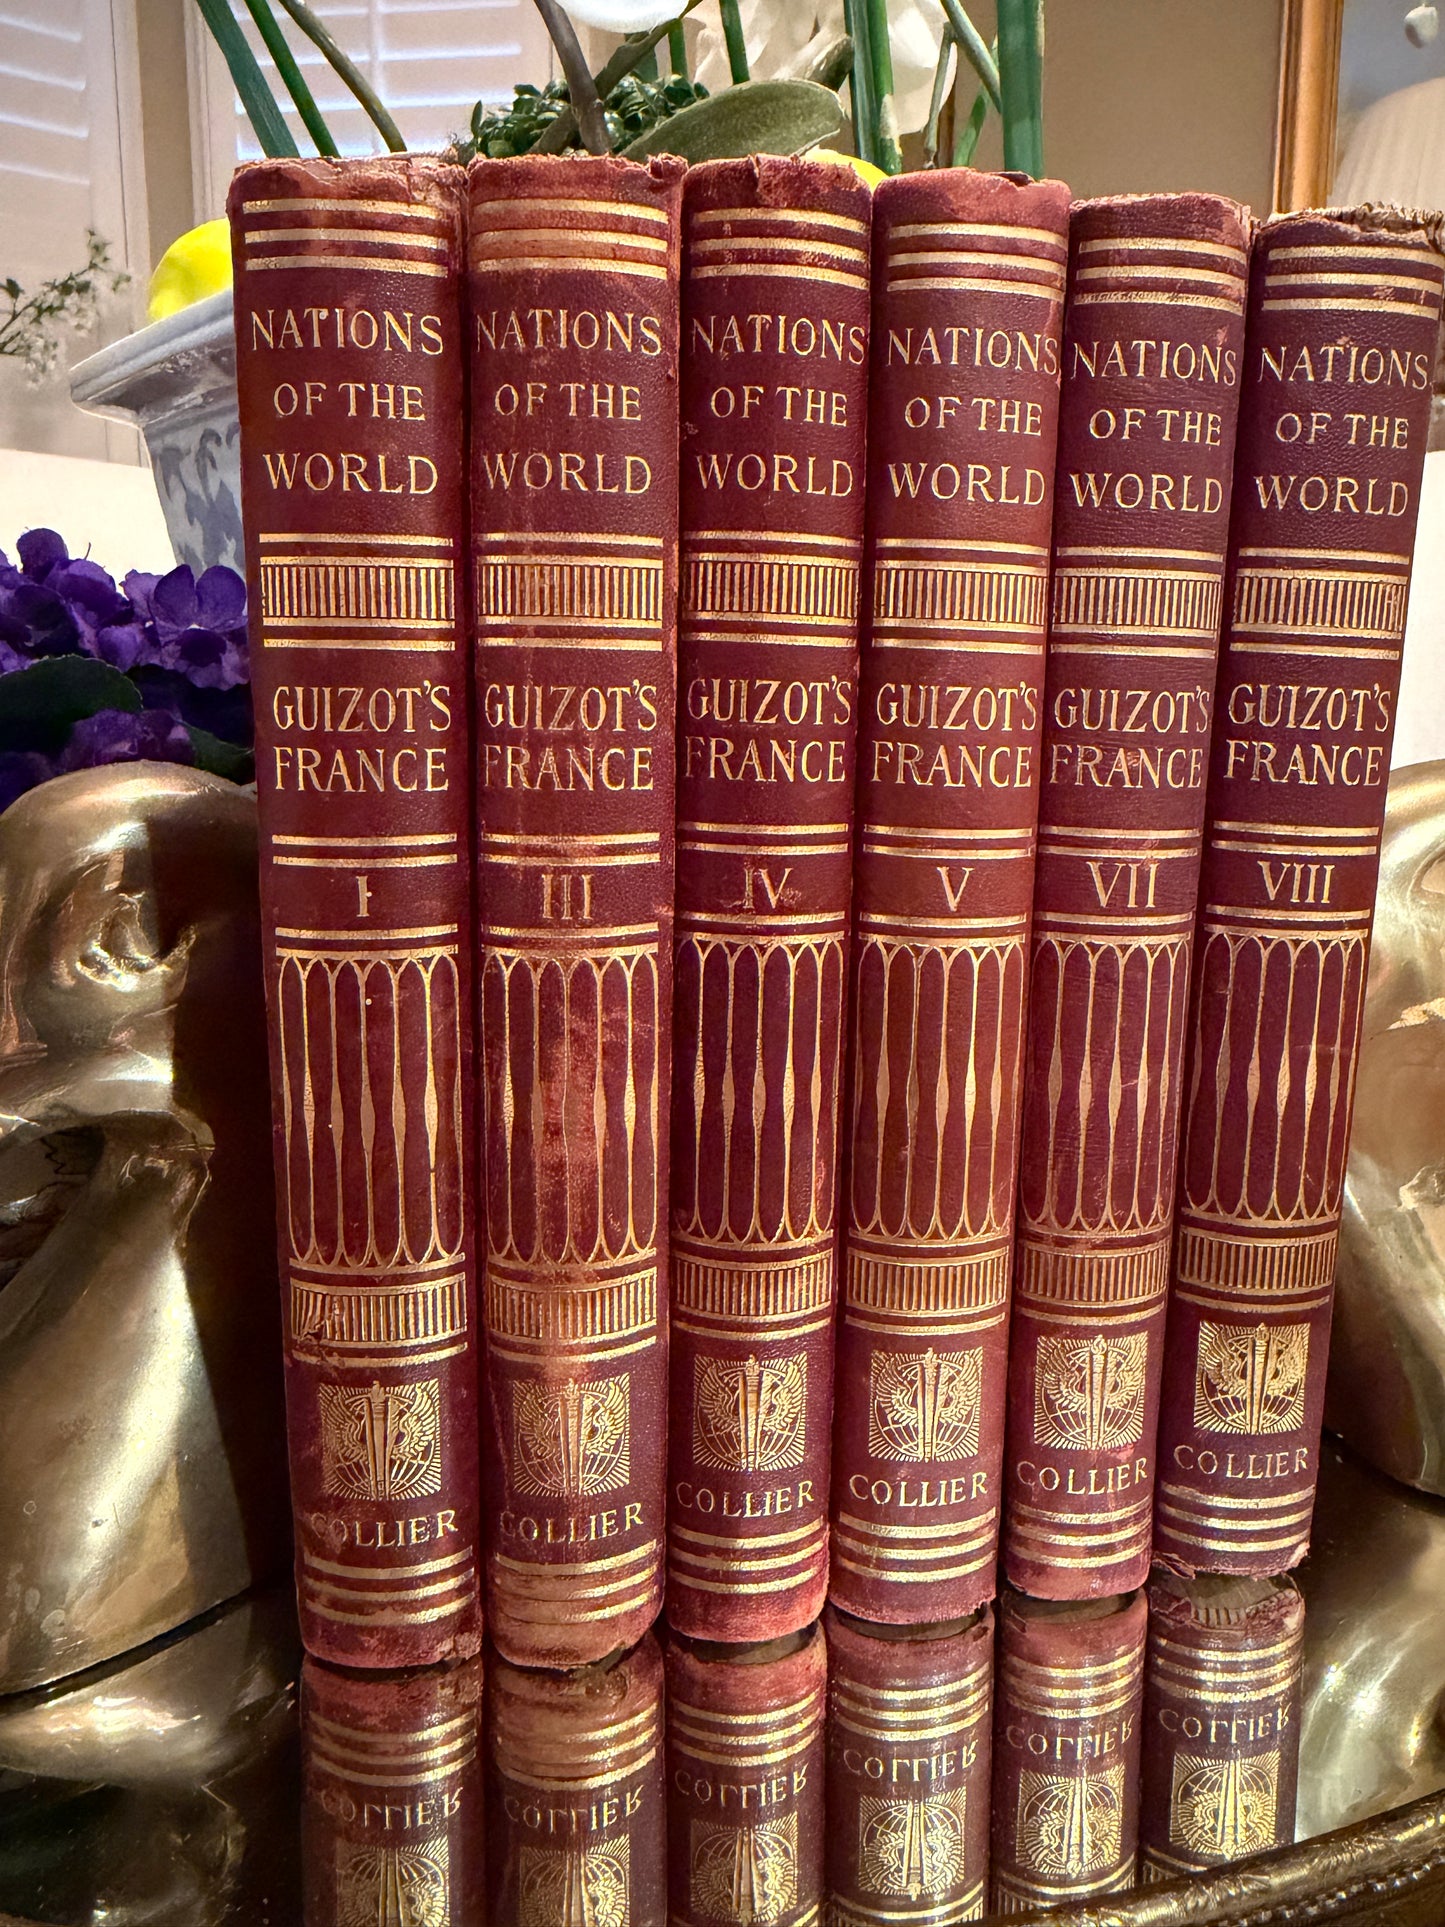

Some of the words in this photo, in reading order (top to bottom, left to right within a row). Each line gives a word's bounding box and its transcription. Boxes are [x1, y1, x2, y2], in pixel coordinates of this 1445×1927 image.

[251, 309, 443, 355] NATIONS
[476, 308, 661, 356] NATIONS
[691, 313, 866, 365] NATIONS
[887, 326, 1058, 376] NATIONS
[1072, 340, 1236, 386] NATIONS
[1258, 345, 1430, 390] NATIONS
[273, 382, 326, 417] OF
[339, 382, 426, 420] THE
[495, 382, 548, 417] OF
[560, 382, 642, 420] THE
[711, 385, 764, 418] OF
[776, 385, 848, 427] THE
[905, 397, 961, 429] OF
[971, 398, 1042, 436] THE
[1089, 408, 1145, 440] OF
[1155, 409, 1222, 446] THE
[1275, 412, 1331, 445] OF
[1342, 413, 1409, 449] THE
[262, 452, 438, 494] WORLD
[482, 452, 651, 494] WORLD
[696, 452, 853, 497] WORLD
[888, 462, 1046, 505] WORLD
[1070, 473, 1223, 513] WORLD
[1254, 475, 1409, 518] WORLD
[273, 680, 451, 733] GUIZOT'S
[483, 679, 658, 732] GUIZOT'S
[688, 675, 852, 725] GUIZOT'S
[876, 681, 1038, 732] GUIZOT'S
[1054, 685, 1210, 735] GUIZOT'S
[1227, 681, 1391, 733] GUIZOT'S
[273, 747, 449, 793] FRANCE
[483, 745, 654, 792] FRANCE
[684, 736, 846, 783] FRANCE
[871, 739, 1033, 788] FRANCE
[1049, 743, 1203, 789] FRANCE
[1223, 739, 1384, 786] FRANCE
[356, 875, 372, 917] I
[541, 873, 594, 920] III
[742, 867, 793, 909] IV
[937, 866, 972, 912] V
[1086, 861, 1157, 909] VII
[1257, 860, 1335, 904] VIII
[1017, 1457, 1148, 1495] COLLIER
[1173, 1444, 1309, 1480] COLLIER
[675, 1479, 814, 1518] COLLIER
[848, 1471, 988, 1507] COLLIER
[500, 1501, 644, 1544] COLLIER
